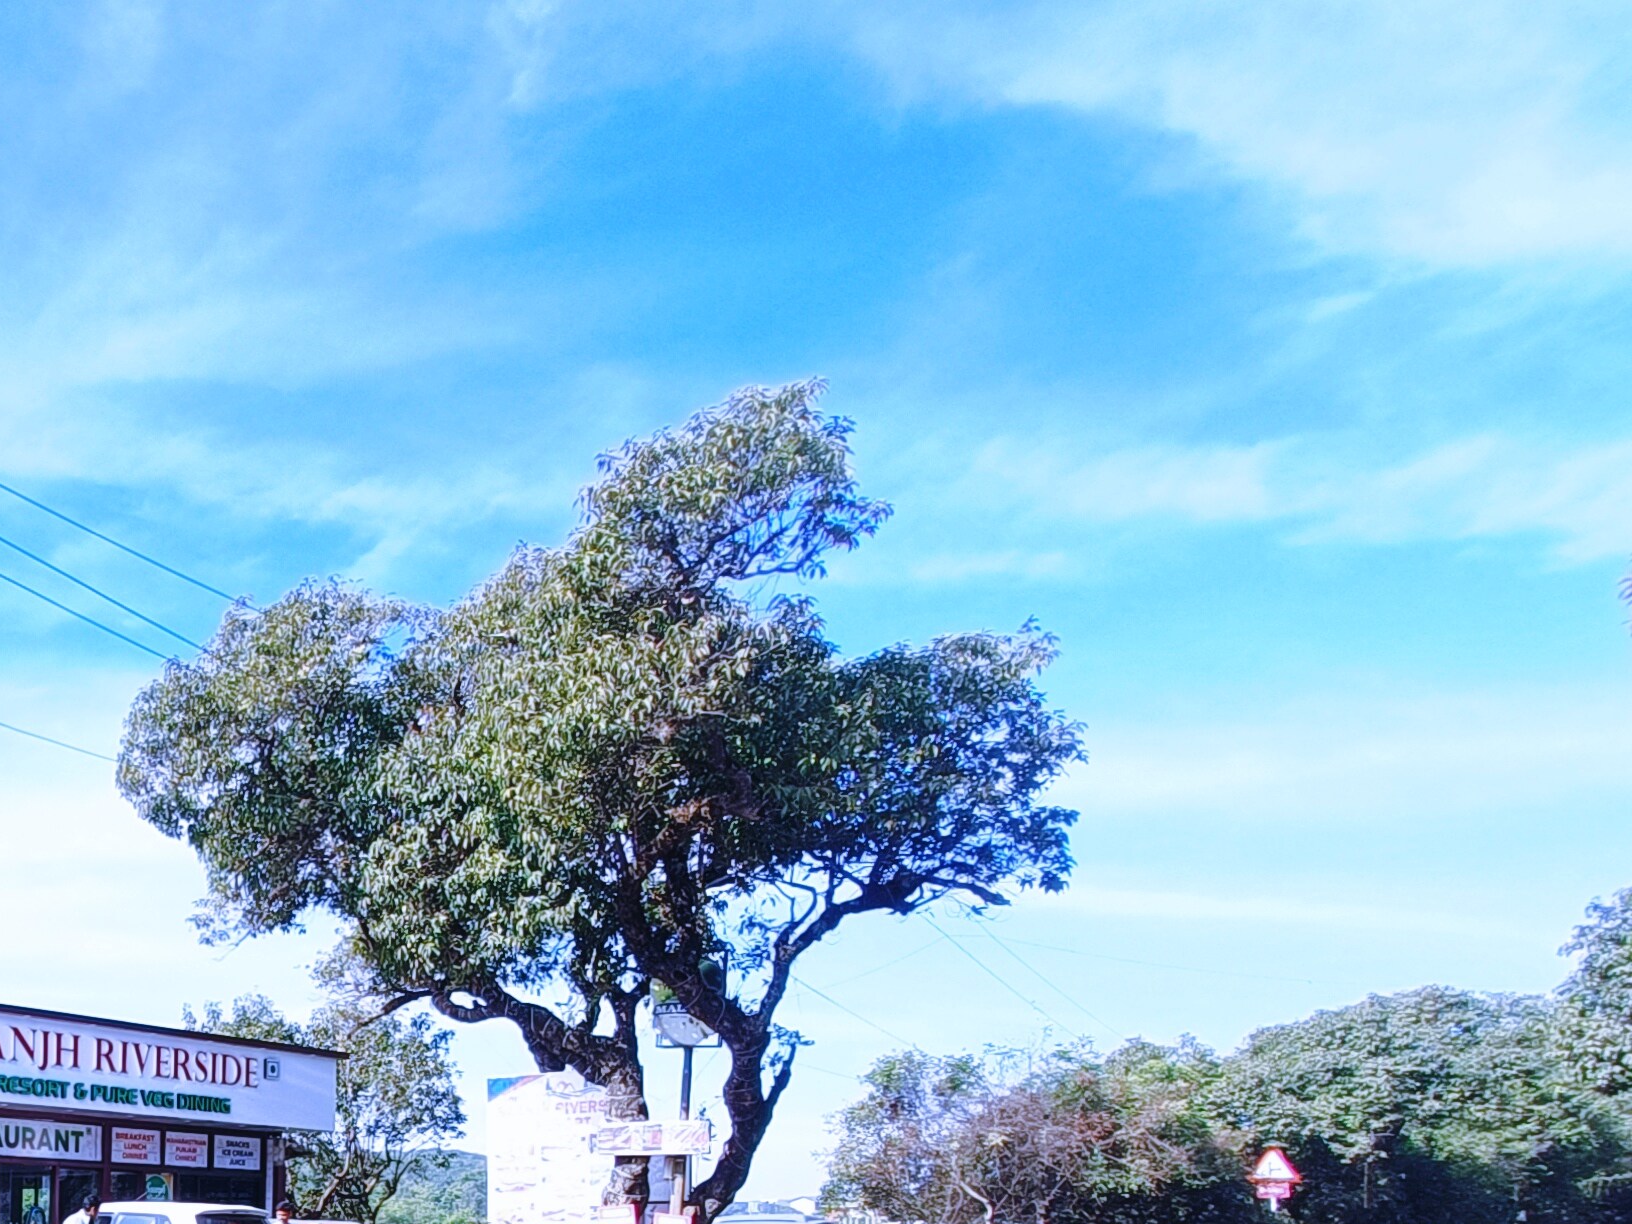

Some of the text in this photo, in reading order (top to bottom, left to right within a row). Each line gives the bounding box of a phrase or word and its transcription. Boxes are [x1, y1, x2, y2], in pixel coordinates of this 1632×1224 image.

[94, 1037, 259, 1089] RIVERSIDE
[73, 1082, 88, 1101] &
[90, 1084, 139, 1106] PURE
[140, 1089, 175, 1109] VEG
[176, 1093, 232, 1114] DINING
[115, 1132, 155, 1142] BREAKFAST
